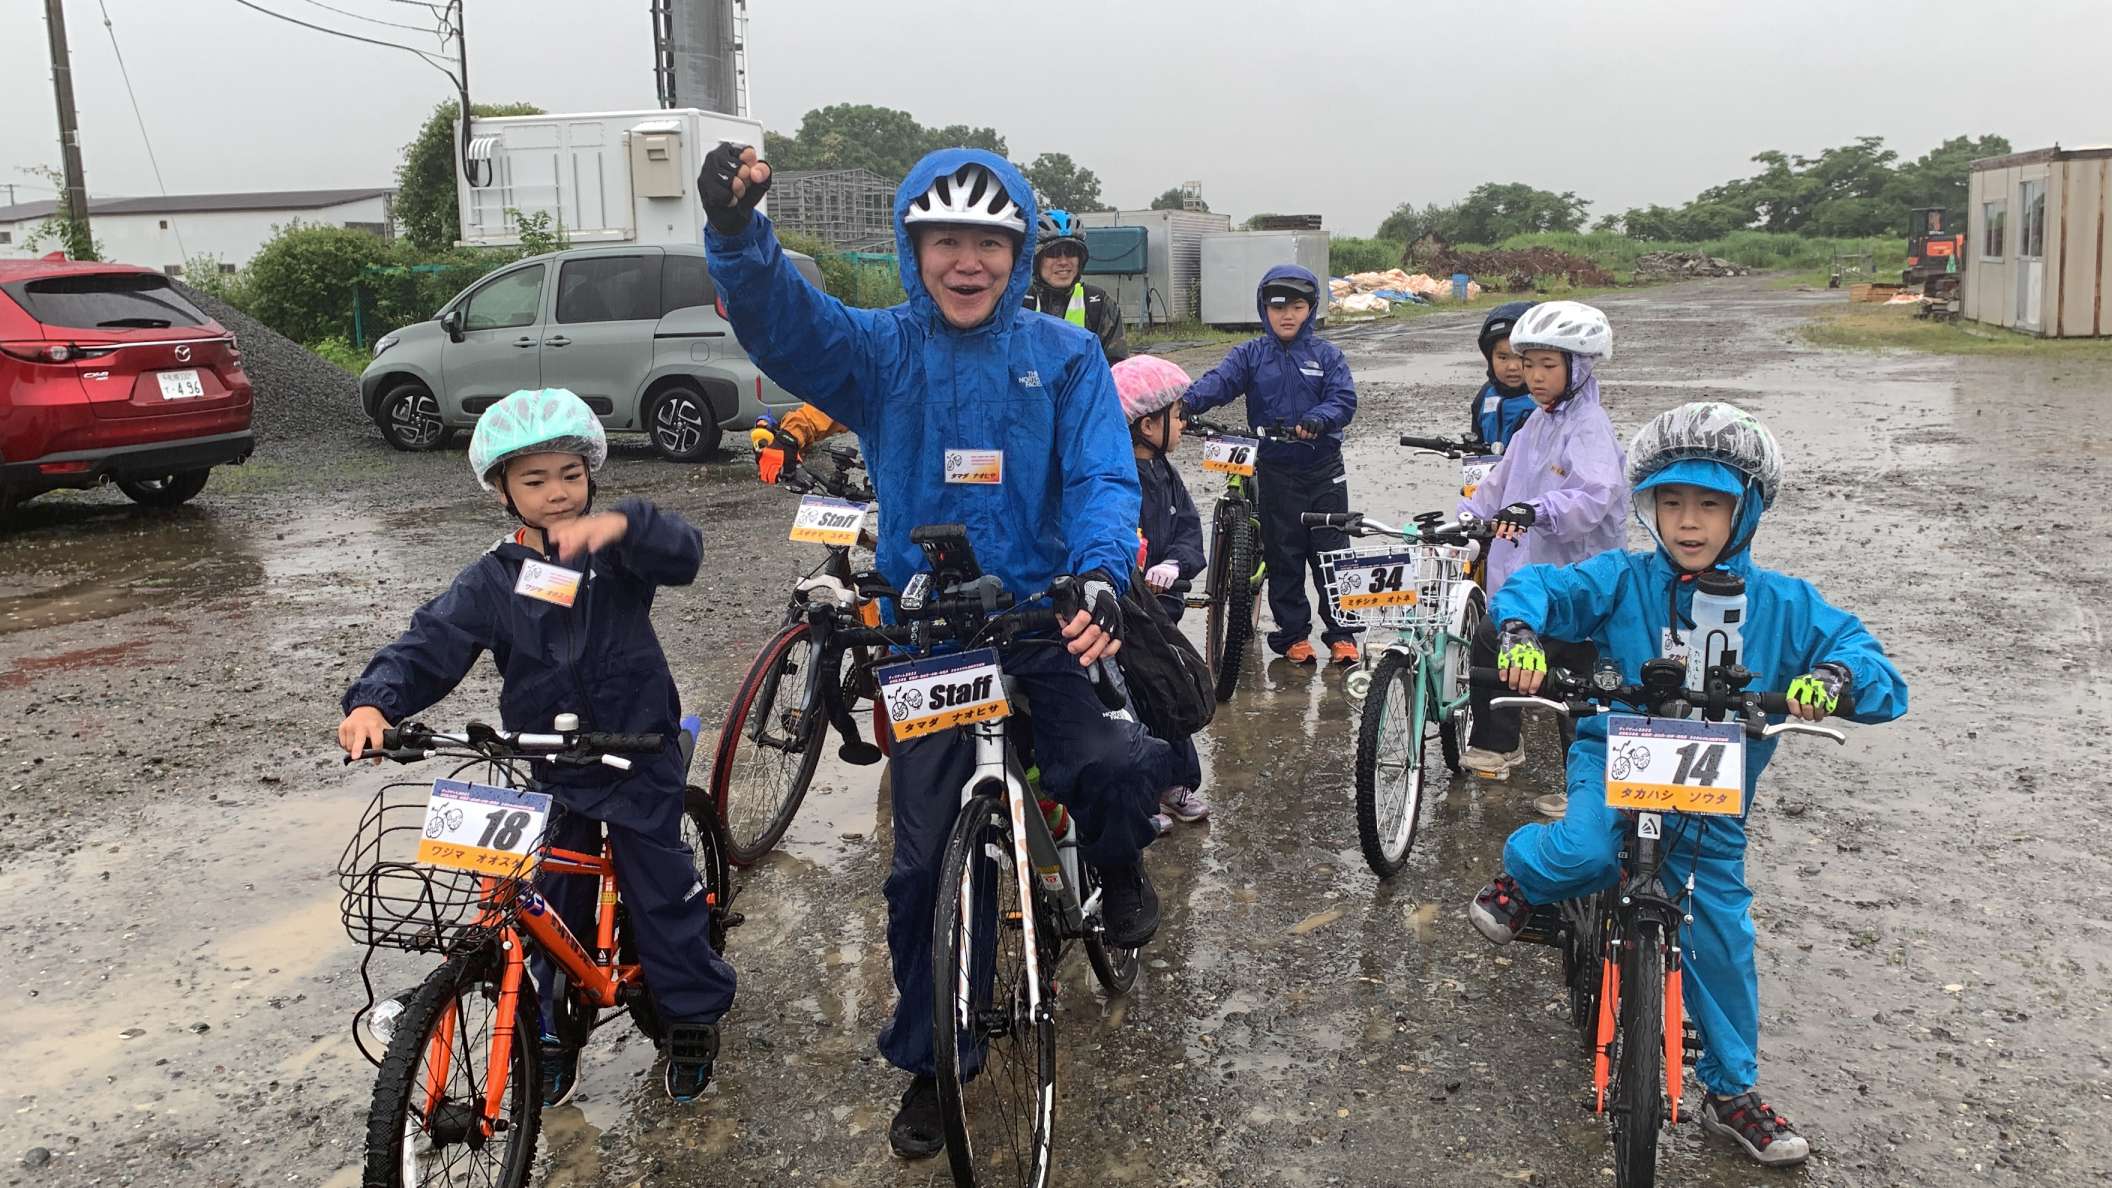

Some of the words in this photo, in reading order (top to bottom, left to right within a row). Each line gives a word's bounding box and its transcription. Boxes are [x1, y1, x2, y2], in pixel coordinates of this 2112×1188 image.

[1227, 446, 1250, 464] 16
[817, 511, 859, 529] Staff
[1368, 566, 1405, 593] 34
[928, 674, 994, 711] Staff
[905, 717, 939, 733] タマダ
[952, 704, 998, 721] ナオヒサ
[1672, 742, 1727, 787] 14
[1621, 788, 1674, 801] タカハシ
[1690, 792, 1728, 804] ソウタ
[477, 808, 531, 851] 18
[432, 846, 465, 859] ワジマ
